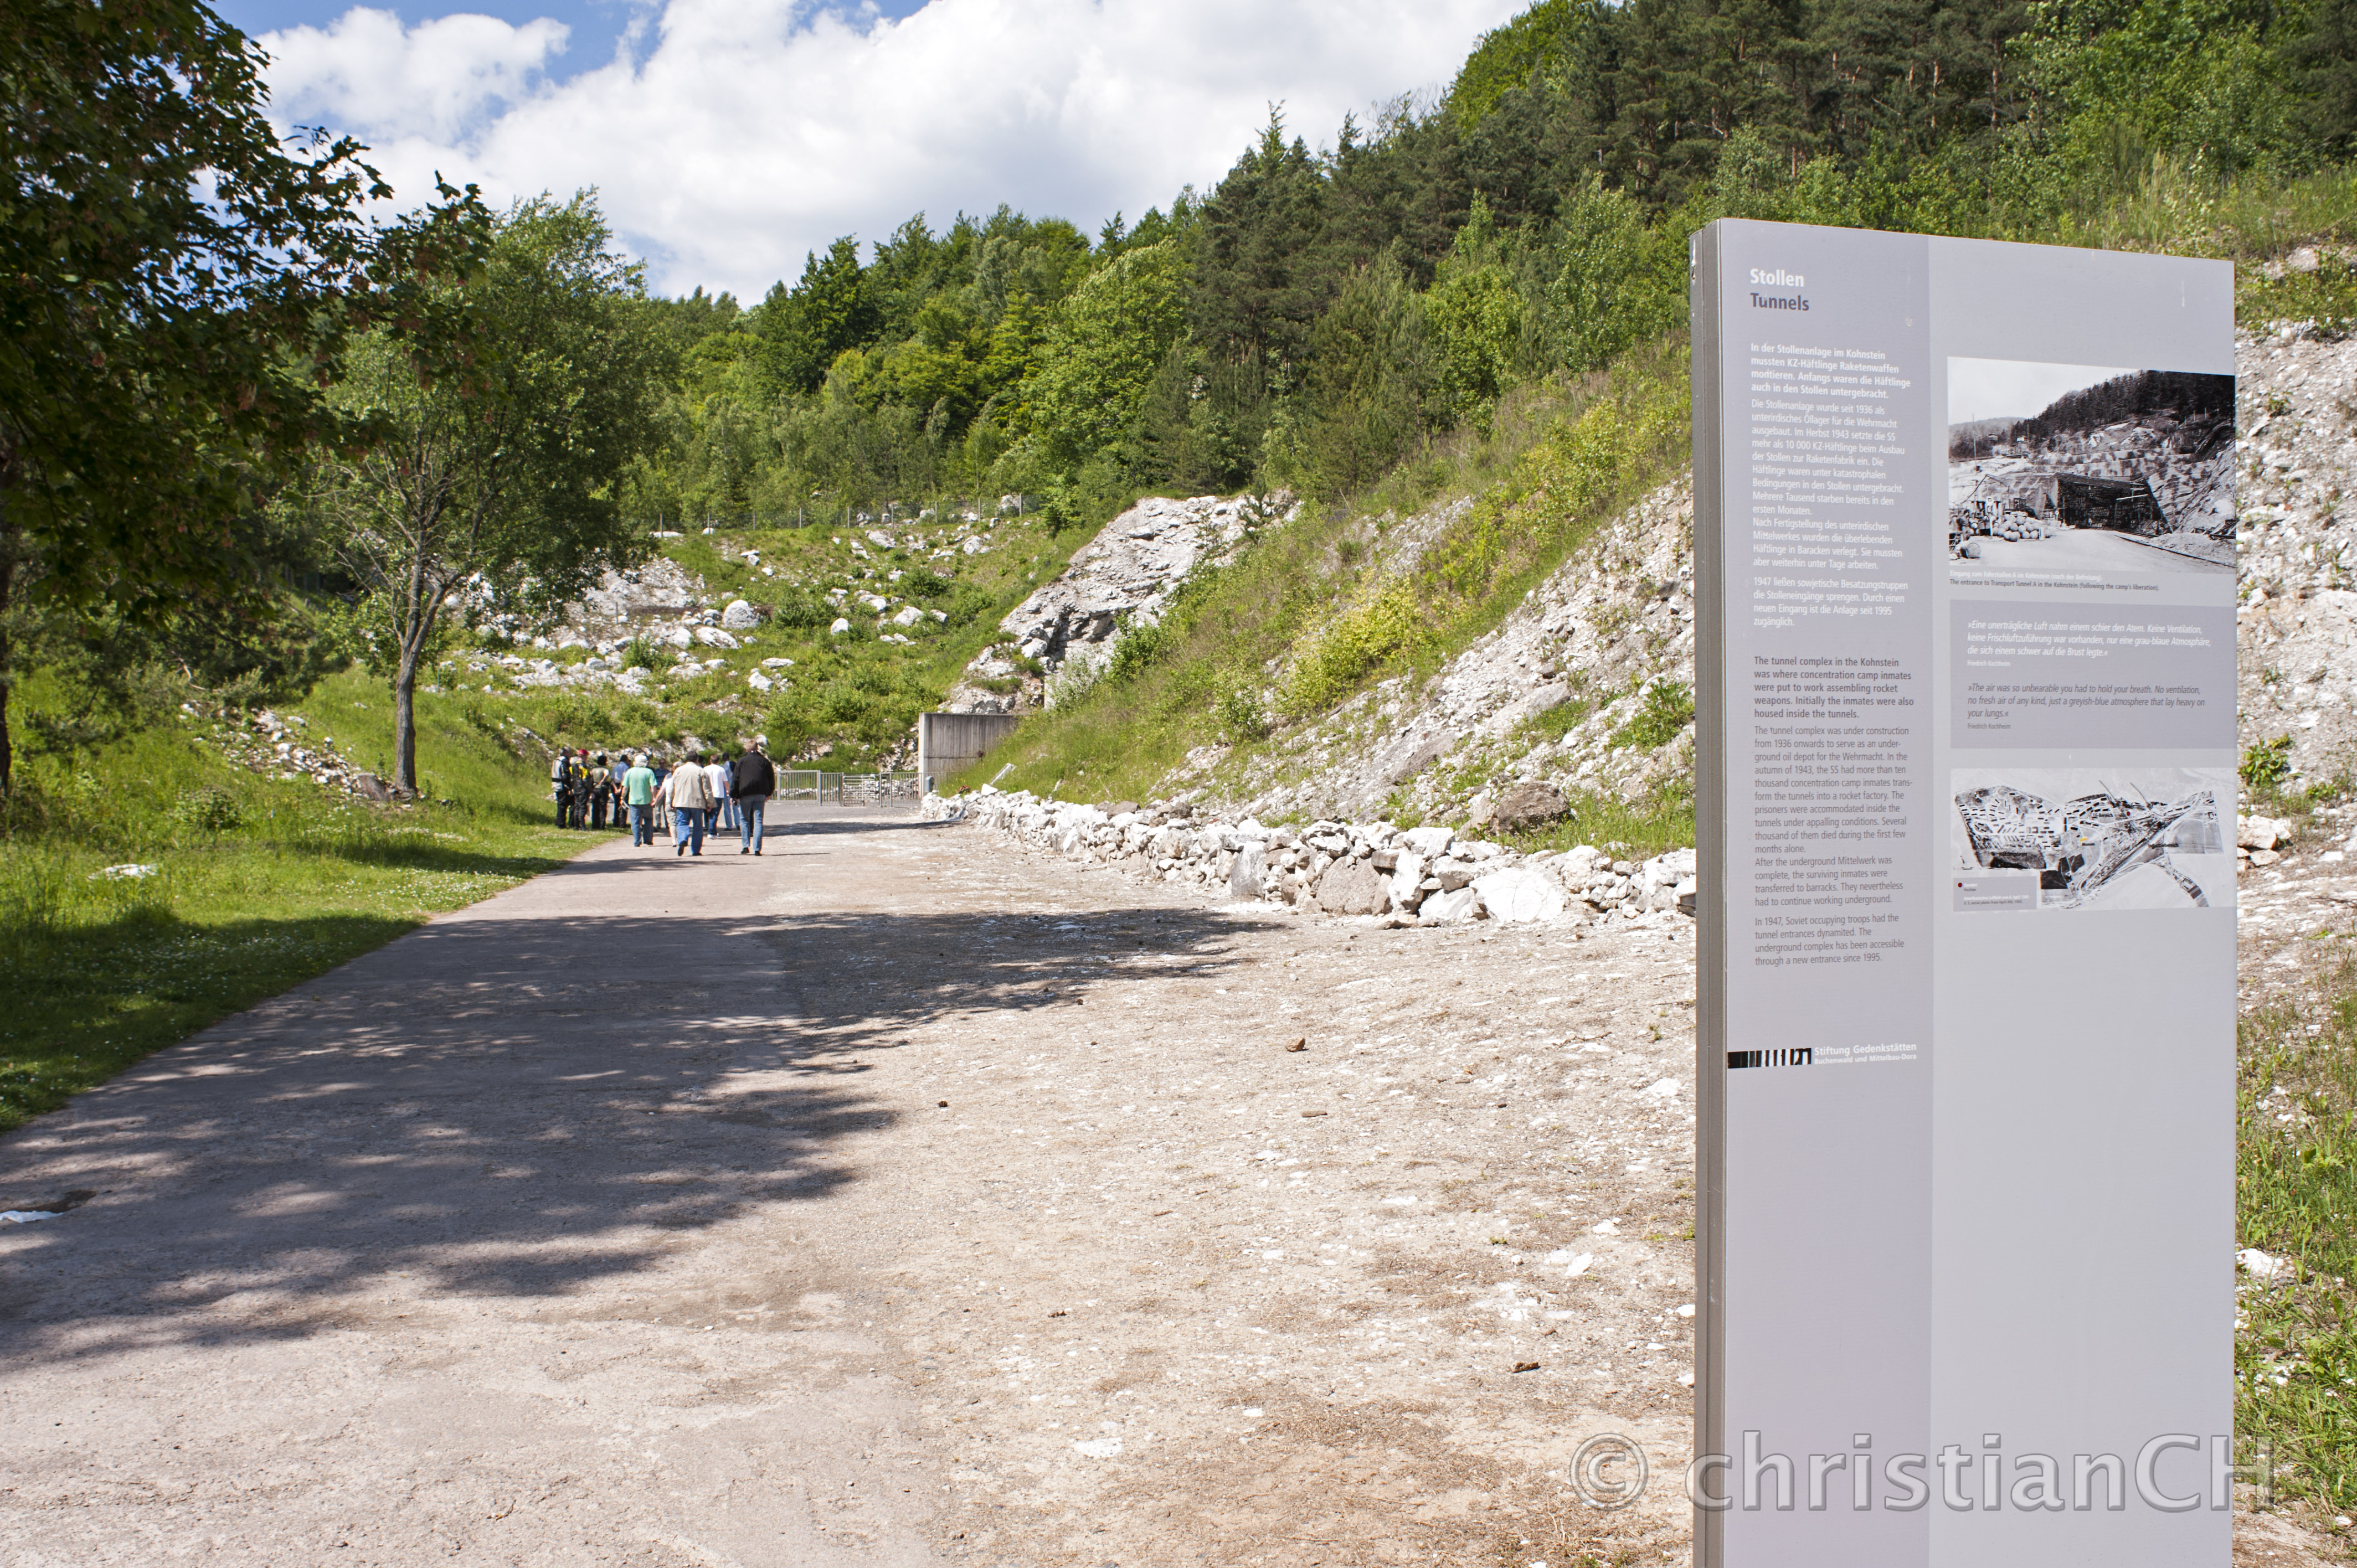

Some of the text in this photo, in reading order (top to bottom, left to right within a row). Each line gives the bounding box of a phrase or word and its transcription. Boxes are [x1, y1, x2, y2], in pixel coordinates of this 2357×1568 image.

[1750, 269, 1804, 287] Stollen
[1750, 293, 1809, 311] Tunnels
[1761, 343, 1774, 352] der
[1777, 344, 1831, 358] Stollenanlage
[1834, 348, 1844, 357] im
[1846, 349, 1885, 359] Kohnstein
[1751, 357, 1898, 373] mussten KZ-Häftlinge Raketenwaffen
[1751, 369, 1795, 380] montieren.
[1798, 372, 1830, 384] Anfangs
[1860, 376, 1872, 384] die
[1875, 376, 1911, 389] Häftlinge
[1751, 383, 1888, 400] auch in den Stollen untergebracht.
[1752, 399, 1763, 408] Die
[1766, 400, 1814, 414] Stollenanlage
[1816, 403, 1839, 412] wurde
[1856, 405, 1873, 414] 1936
[1875, 406, 1885, 414] als
[1752, 413, 1897, 428] unterirdisches Öllager für die Wehrmacht
[1752, 426, 1792, 438] ausgebaut.
[1806, 429, 1829, 437] Herbst
[1832, 430, 1849, 439] 1943
[1874, 432, 1885, 440] die
[1887, 432, 1896, 441] SS
[1754, 577, 1908, 591] 1947 ließen sowjetische Besatzungstruppen
[1753, 590, 1905, 603] die Stolleneingänge sprengen. Durch einen
[1779, 604, 1807, 615] Eingang
[1810, 605, 1818, 613] ist
[1820, 605, 1831, 613] die
[1833, 605, 1858, 616] Anlage
[1860, 606, 1872, 615] seit
[1875, 606, 1892, 615] 1995
[1754, 617, 1794, 628] zugänglich.
[1988, 621, 2032, 631] unerträgliche
[2091, 623, 2111, 631] schier
[2165, 625, 2202, 635] Ventilation,
[1754, 656, 1768, 664] The
[1772, 657, 1797, 665] tunnel
[1800, 657, 1833, 667] complex
[1861, 658, 1898, 666] Kohnstein
[1800, 670, 1854, 679] concentration
[1881, 671, 1911, 679] inmates
[1777, 684, 1790, 693] put
[1826, 684, 1871, 694] assembling
[2021, 684, 2059, 692] unbearable
[2165, 685, 2201, 695] ventilation,
[1754, 698, 1792, 706] weapons.
[1796, 696, 1825, 706] Initially
[1843, 697, 1874, 705] inmates
[1898, 697, 1913, 705] also
[1754, 709, 1783, 717] housed
[1787, 709, 1810, 718] inside
[1812, 709, 1825, 718] the
[1765, 917, 1783, 927] 1947,
[1786, 916, 1808, 925] Soviet
[1810, 915, 1845, 926] occupying
[1847, 915, 1870, 925] troops
[1755, 930, 1778, 939] tunnel
[1780, 930, 1815, 938] entrances
[1817, 928, 1856, 939] dynamited.
[1756, 942, 1802, 954] underground
[1804, 942, 1833, 952] complex
[1870, 939, 1904, 948] accessible
[1755, 956, 1783, 967] through
[1810, 955, 1841, 963] entrance
[1864, 953, 1882, 961] 1995.
[1815, 1043, 1916, 1057] Stiftung Gedenkstätten
